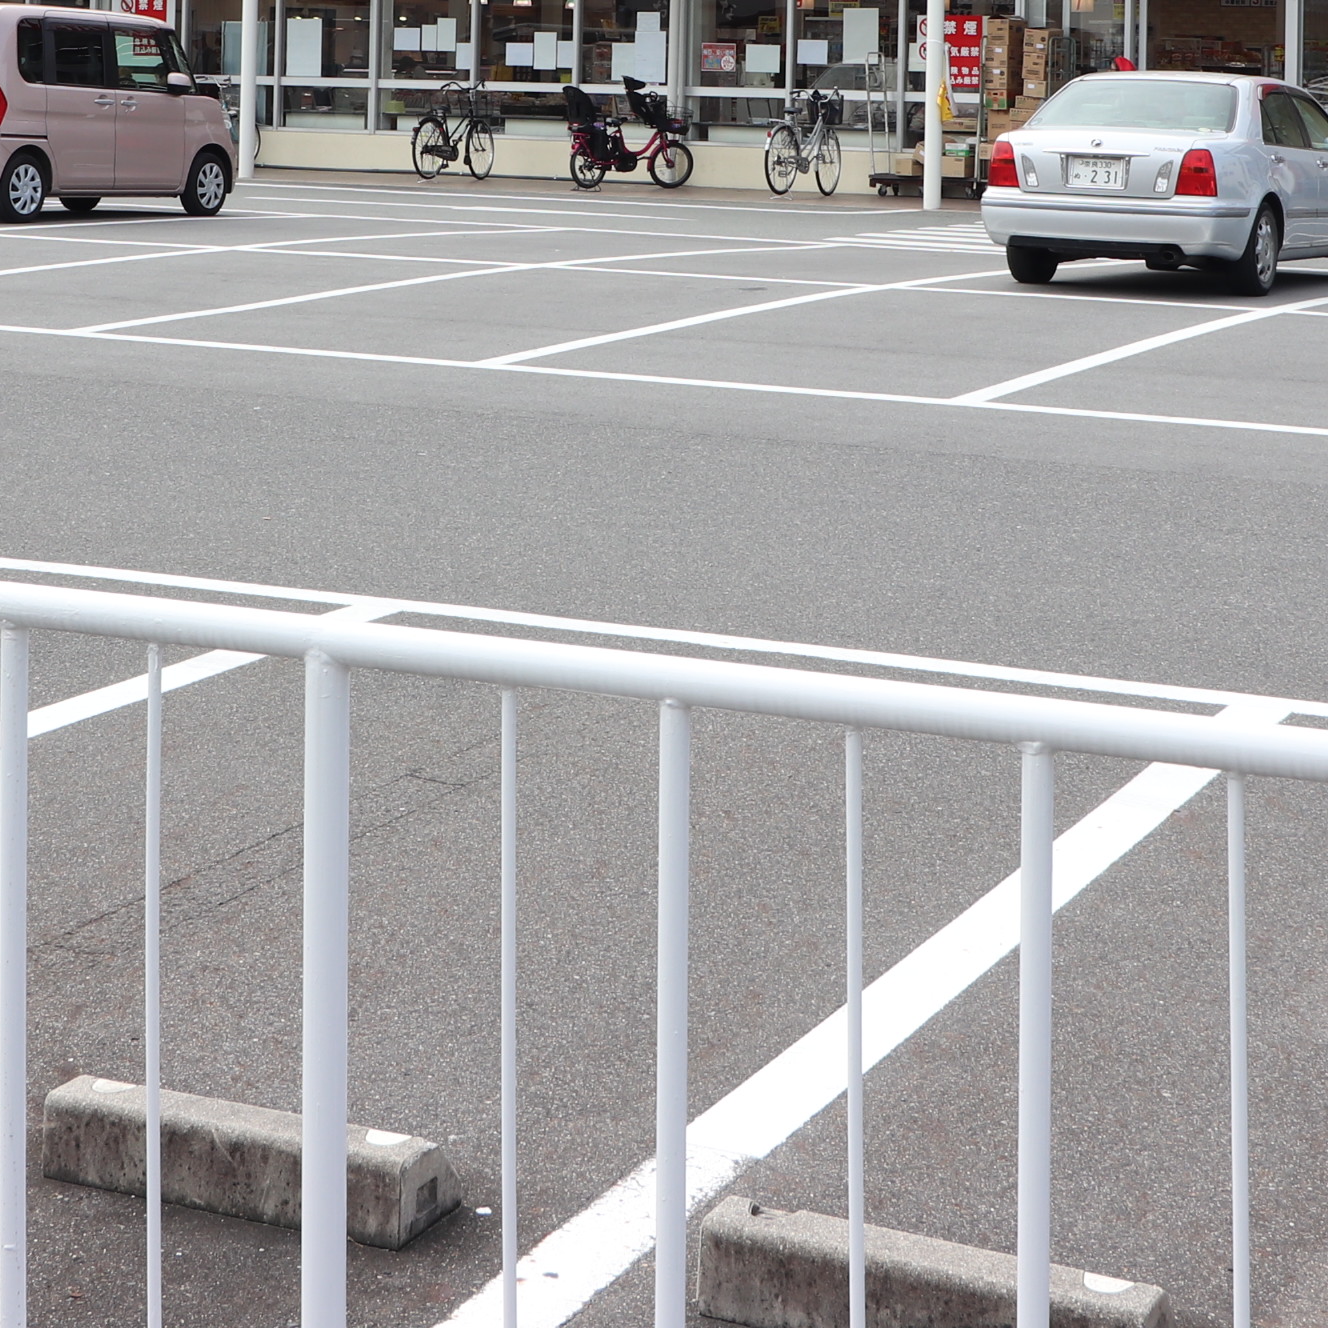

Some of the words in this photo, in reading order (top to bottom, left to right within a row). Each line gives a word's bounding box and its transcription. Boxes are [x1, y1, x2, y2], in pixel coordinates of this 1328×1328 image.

[943, 20, 978, 36] 禁煙
[950, 46, 980, 57] 気厳禁
